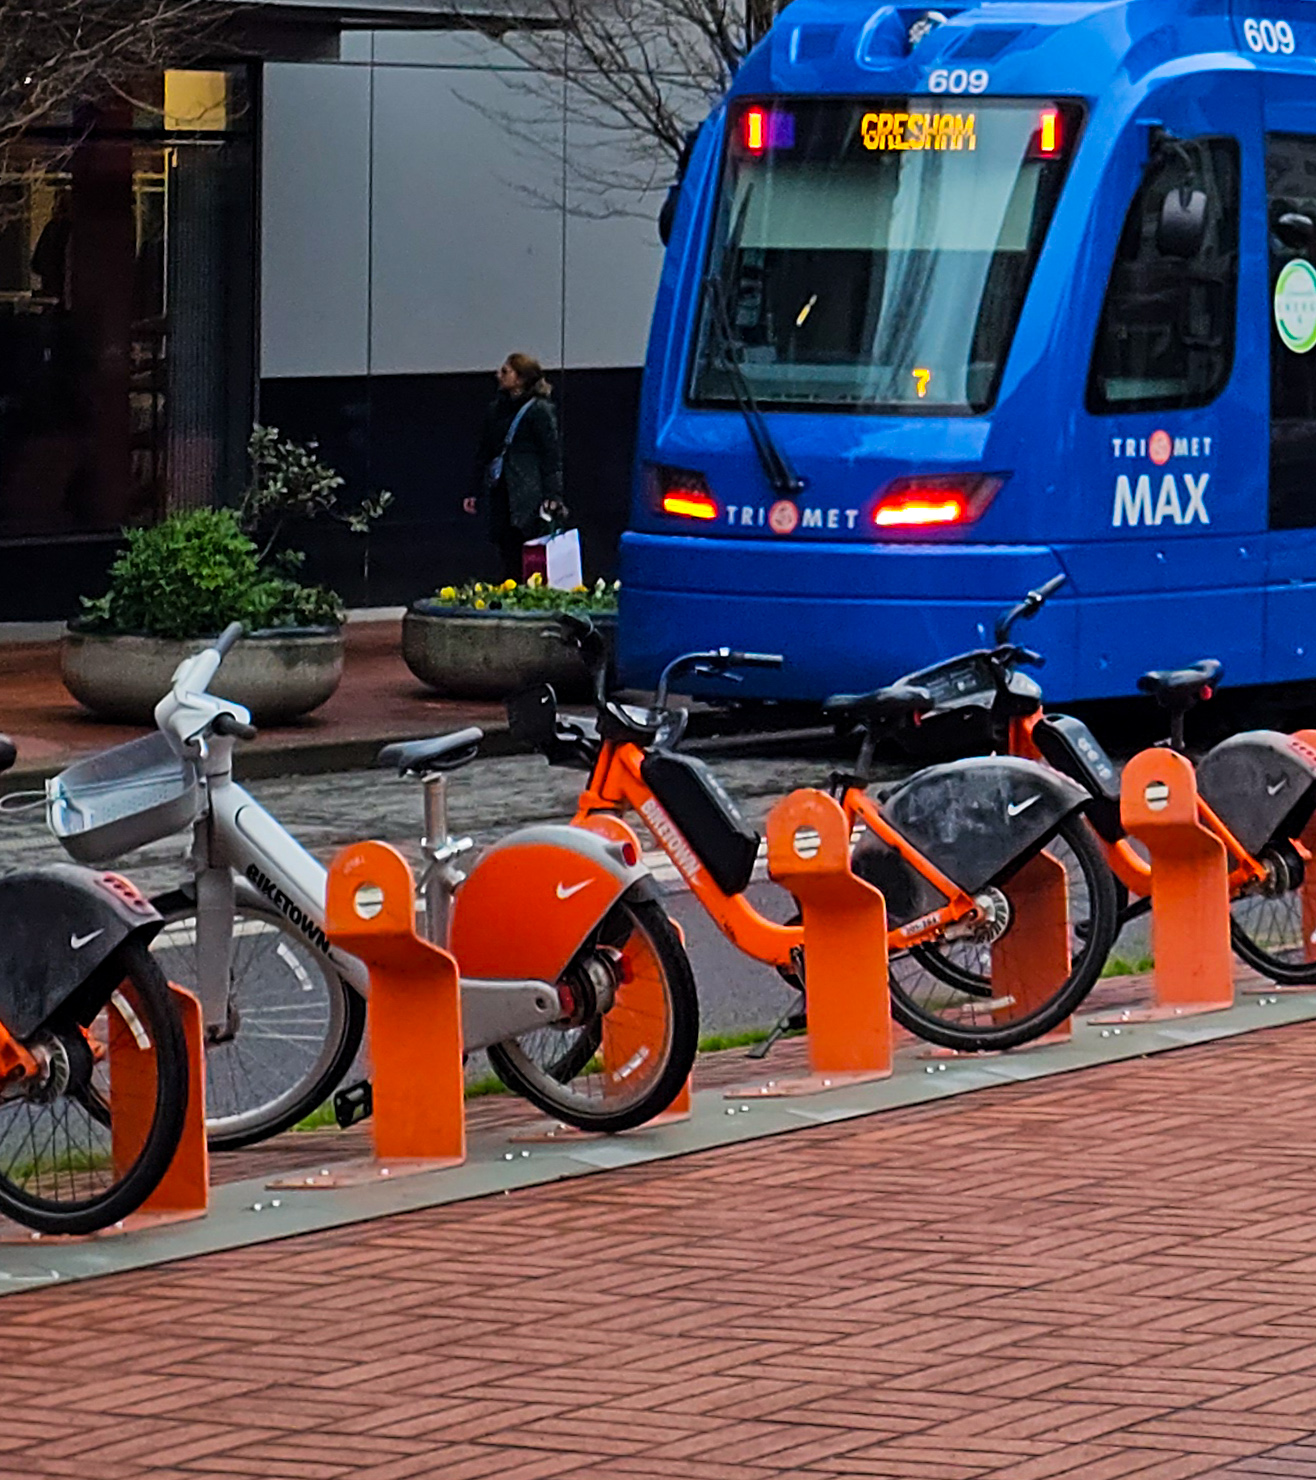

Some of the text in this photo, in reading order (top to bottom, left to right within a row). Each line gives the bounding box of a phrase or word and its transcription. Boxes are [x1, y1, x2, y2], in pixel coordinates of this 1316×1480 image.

[1243, 18, 1295, 55] 609
[928, 69, 989, 93] 609
[861, 112, 976, 151] GRESHAM
[912, 368, 931, 398] 7
[1112, 473, 1211, 527] MAX
[640, 796, 700, 878] BIKETOWN
[246, 863, 330, 955] BIKETOWN
